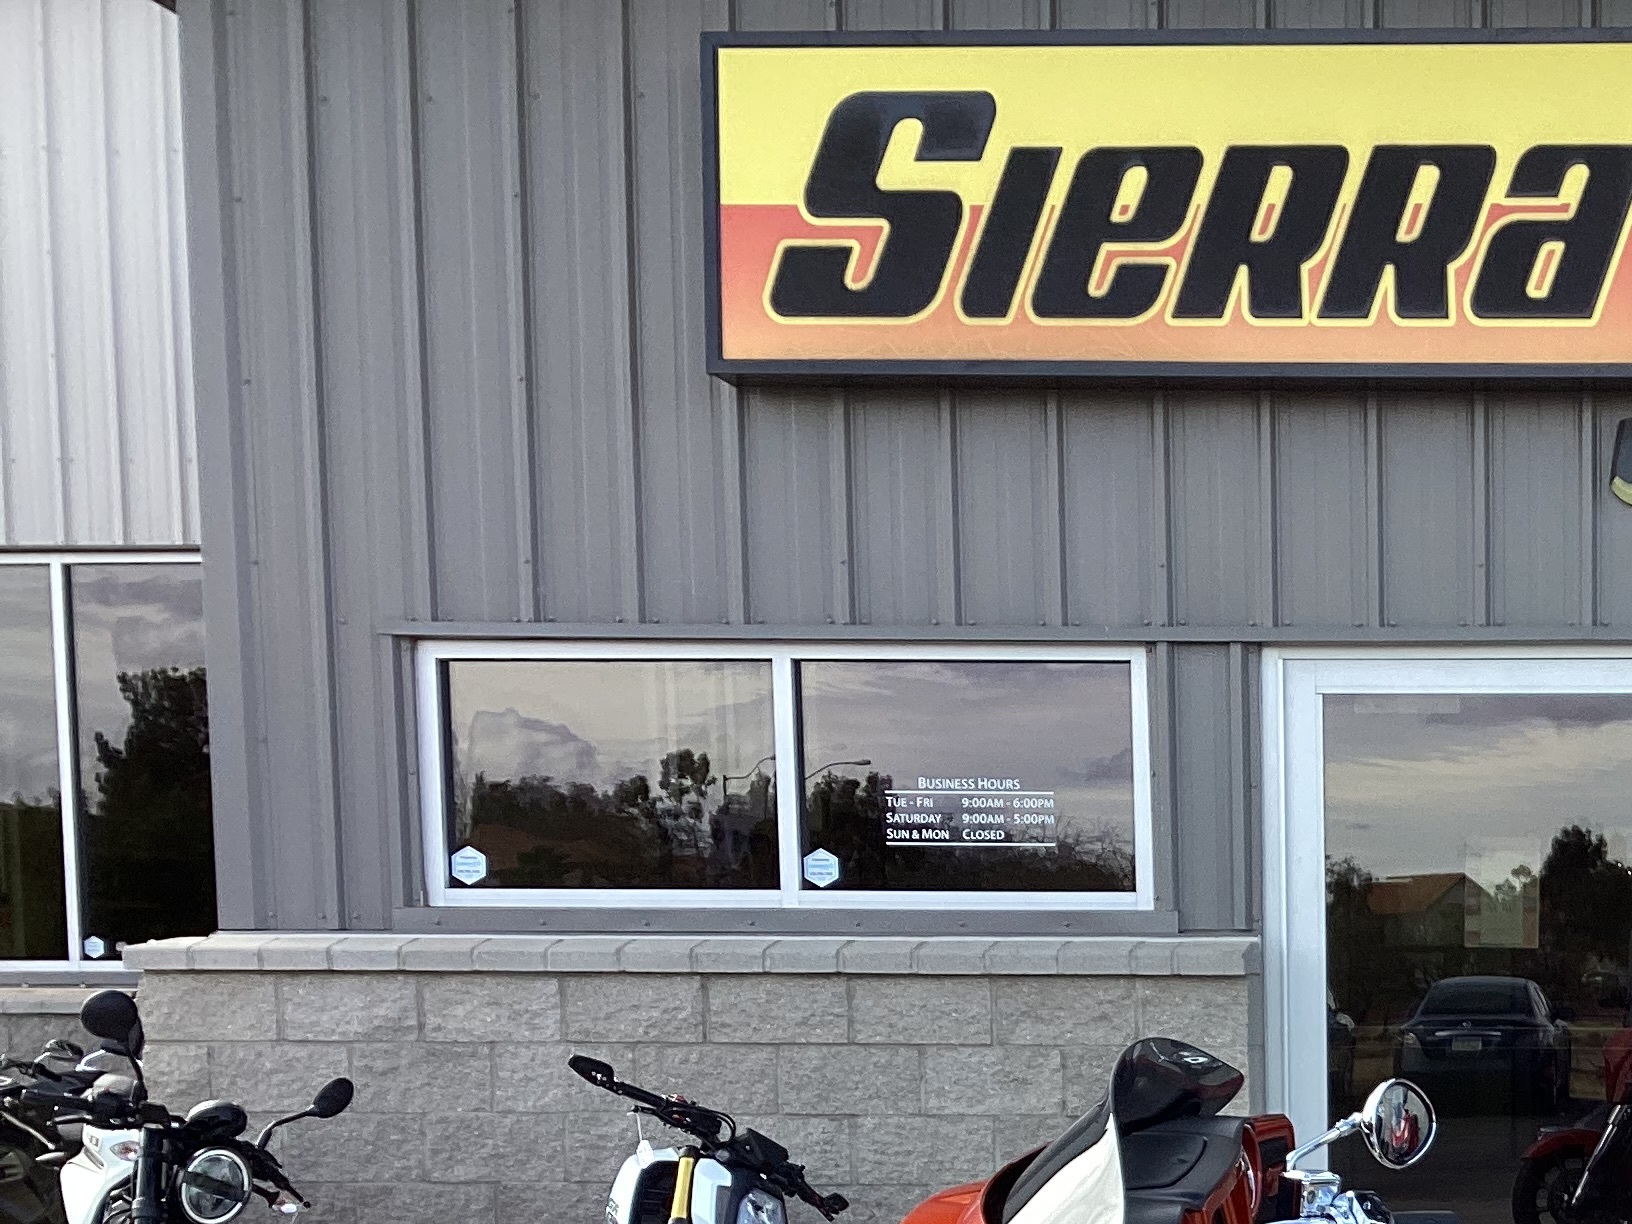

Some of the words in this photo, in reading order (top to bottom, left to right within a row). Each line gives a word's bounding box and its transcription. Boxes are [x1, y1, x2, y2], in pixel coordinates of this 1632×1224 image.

[917, 777, 975, 790] BUSINESS
[977, 778, 1020, 790] HOURS
[886, 796, 907, 808] TUE
[916, 797, 934, 808] FRI
[961, 798, 1004, 808] 9:00AM
[1012, 798, 1054, 809] 6:00PM
[886, 812, 942, 825] SATURDAY
[962, 813, 1004, 824] 9:00AM
[1013, 813, 1055, 825] 5:00PM
[886, 828, 910, 840] SUN
[911, 830, 920, 840] &
[921, 829, 950, 840] MON
[962, 829, 1005, 840] CLOSED
